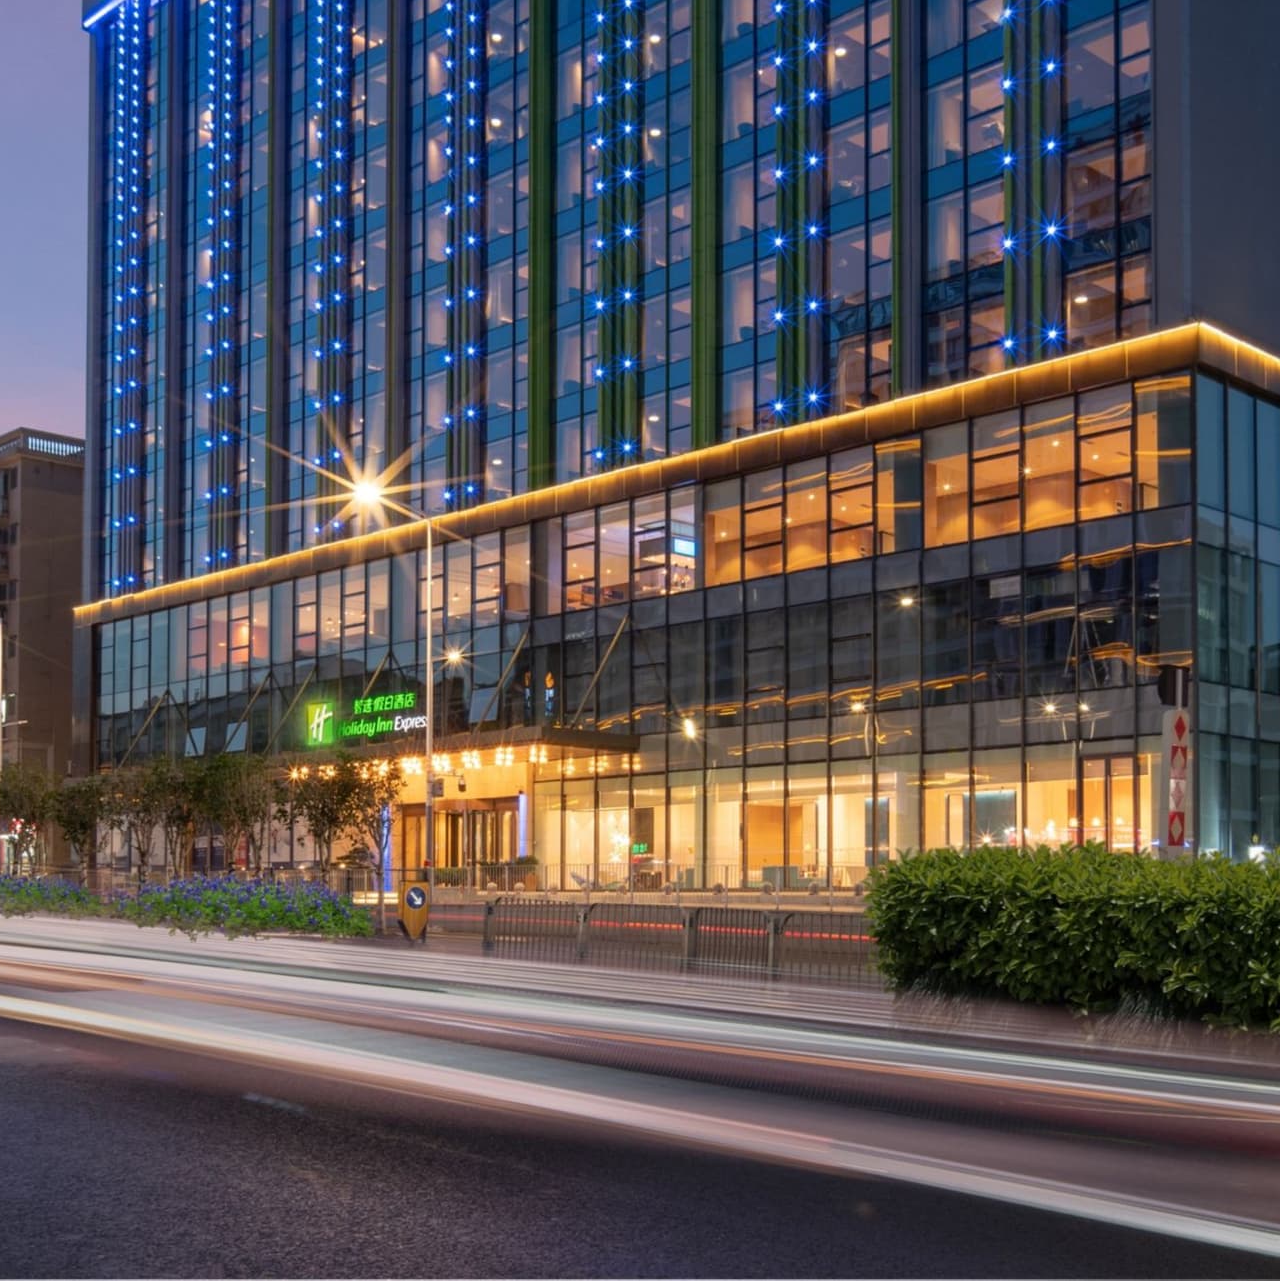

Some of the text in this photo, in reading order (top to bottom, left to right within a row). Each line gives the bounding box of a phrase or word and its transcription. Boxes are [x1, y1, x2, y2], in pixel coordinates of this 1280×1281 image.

[338, 715, 428, 737] Holiday Inn Expres
